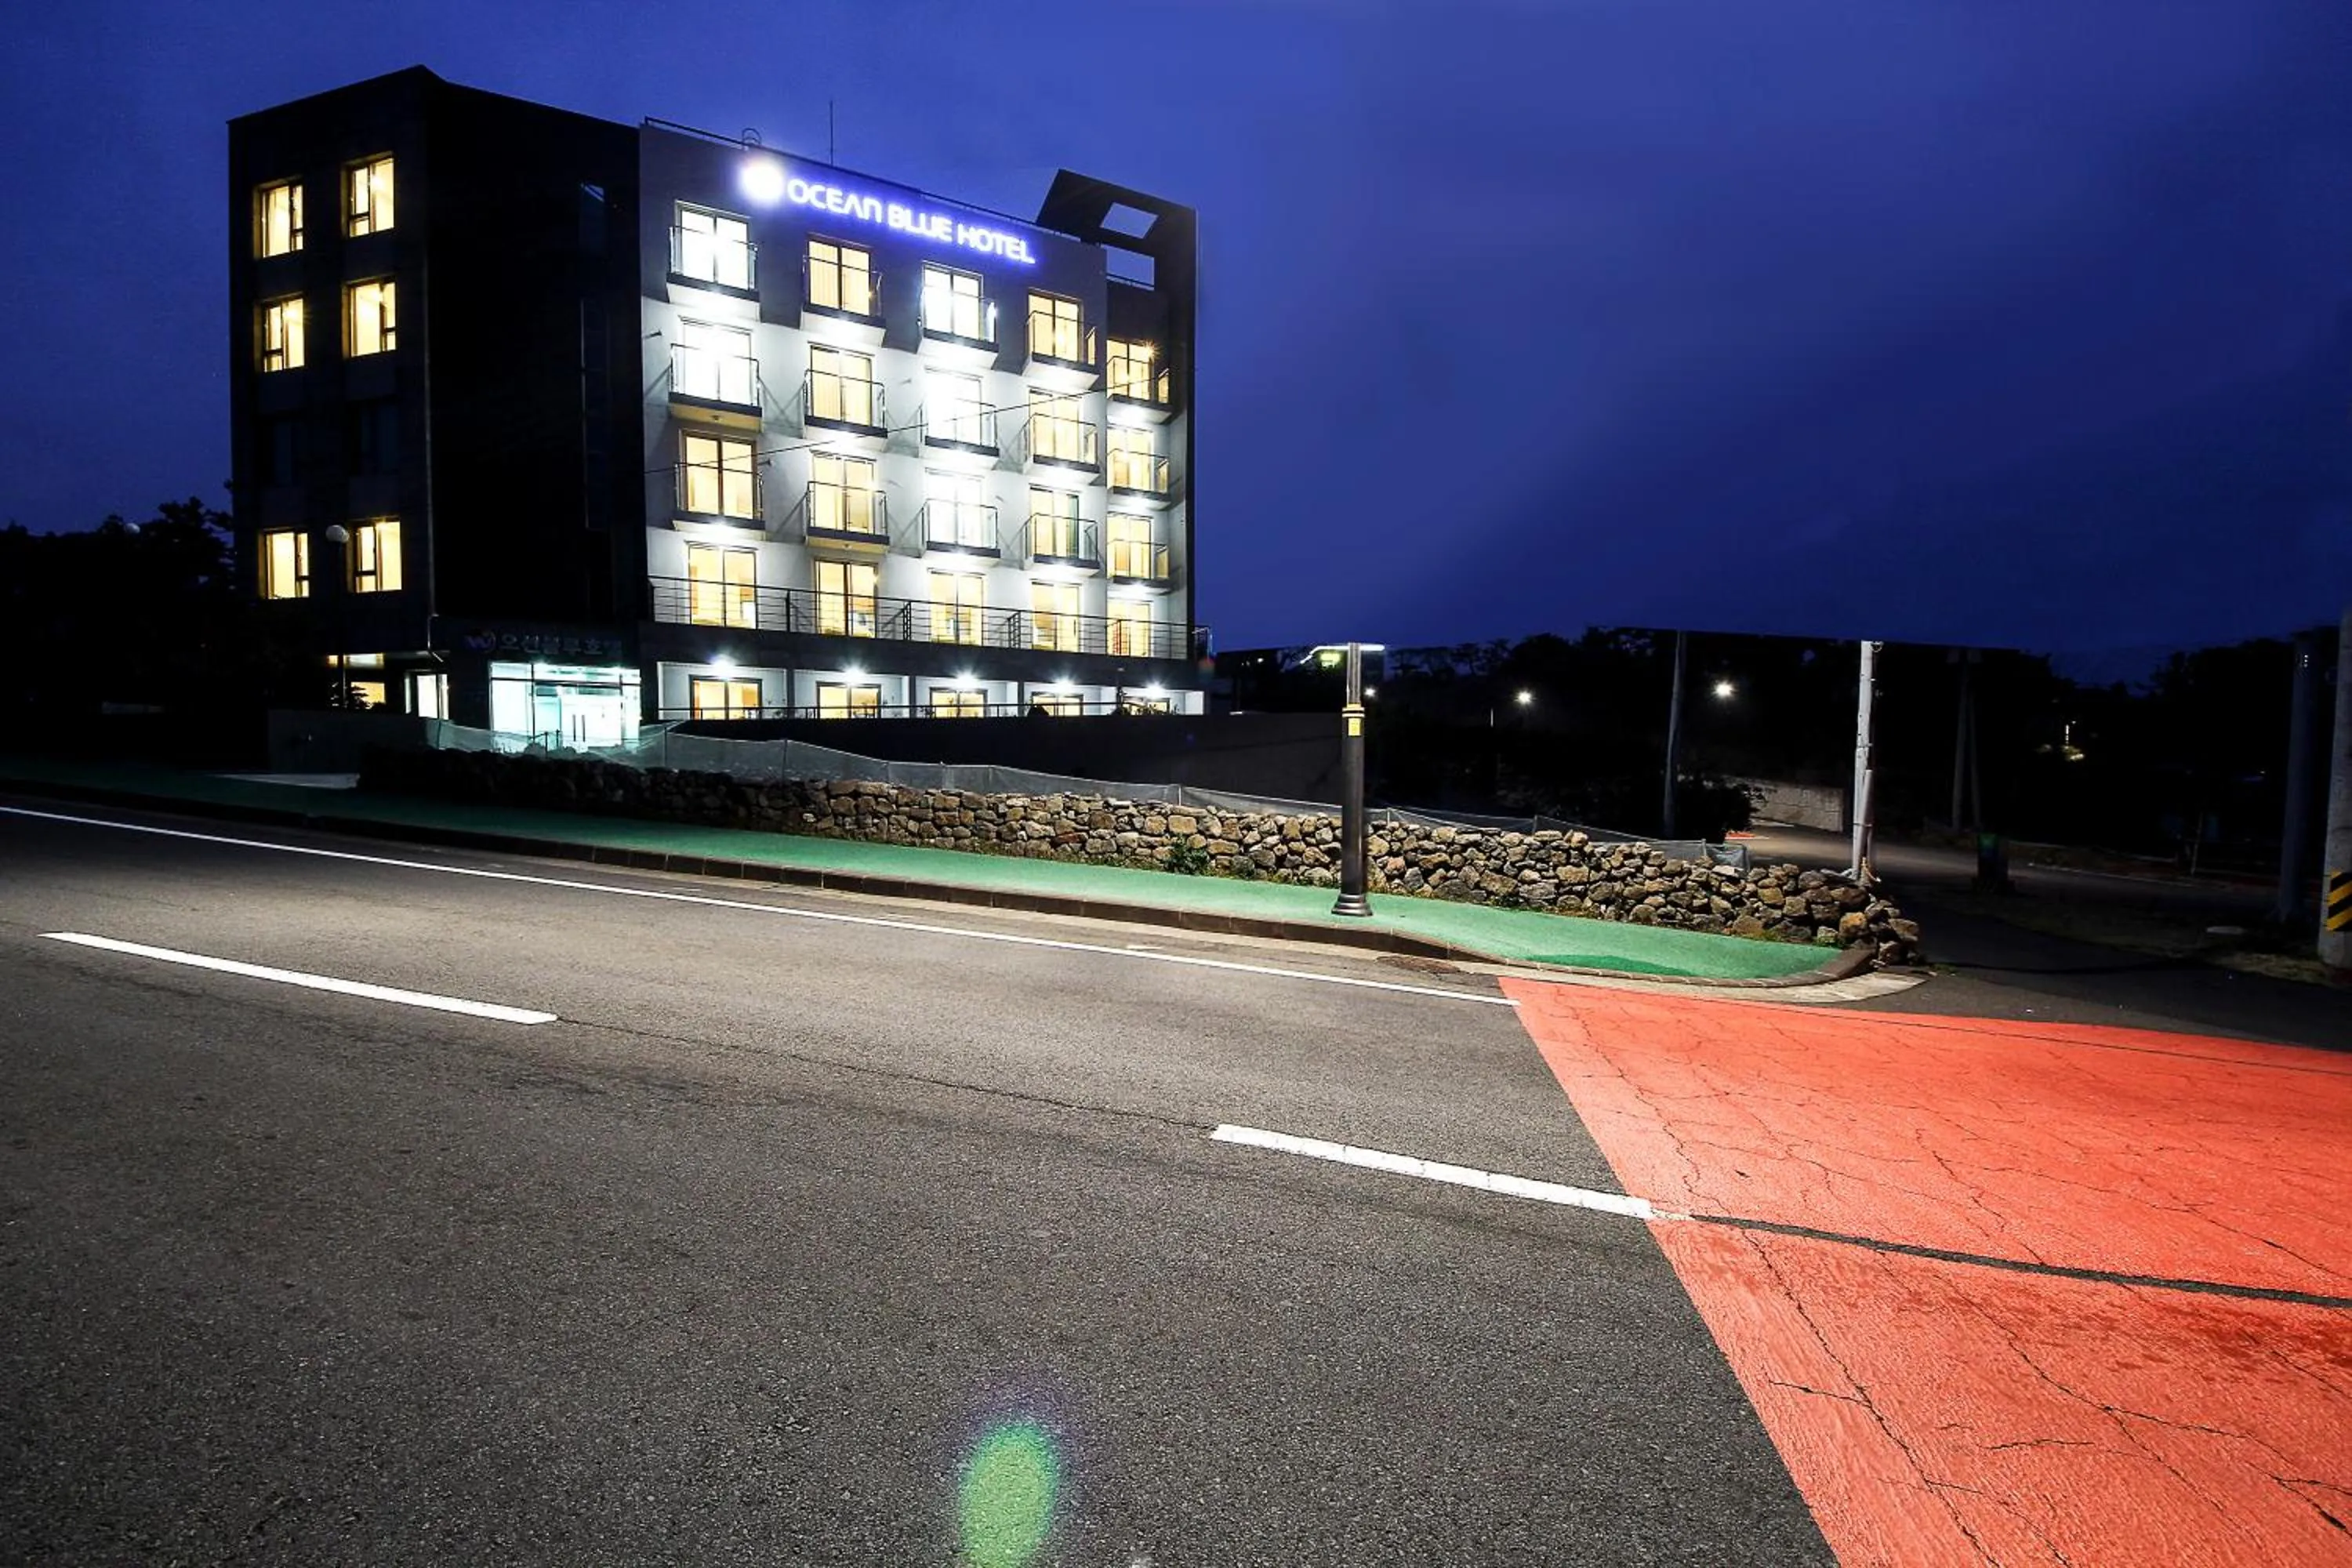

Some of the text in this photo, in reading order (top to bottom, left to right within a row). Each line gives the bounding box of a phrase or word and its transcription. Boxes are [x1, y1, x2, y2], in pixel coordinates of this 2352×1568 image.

[786, 178, 1036, 264] OCEAN BLUE HOTEL
